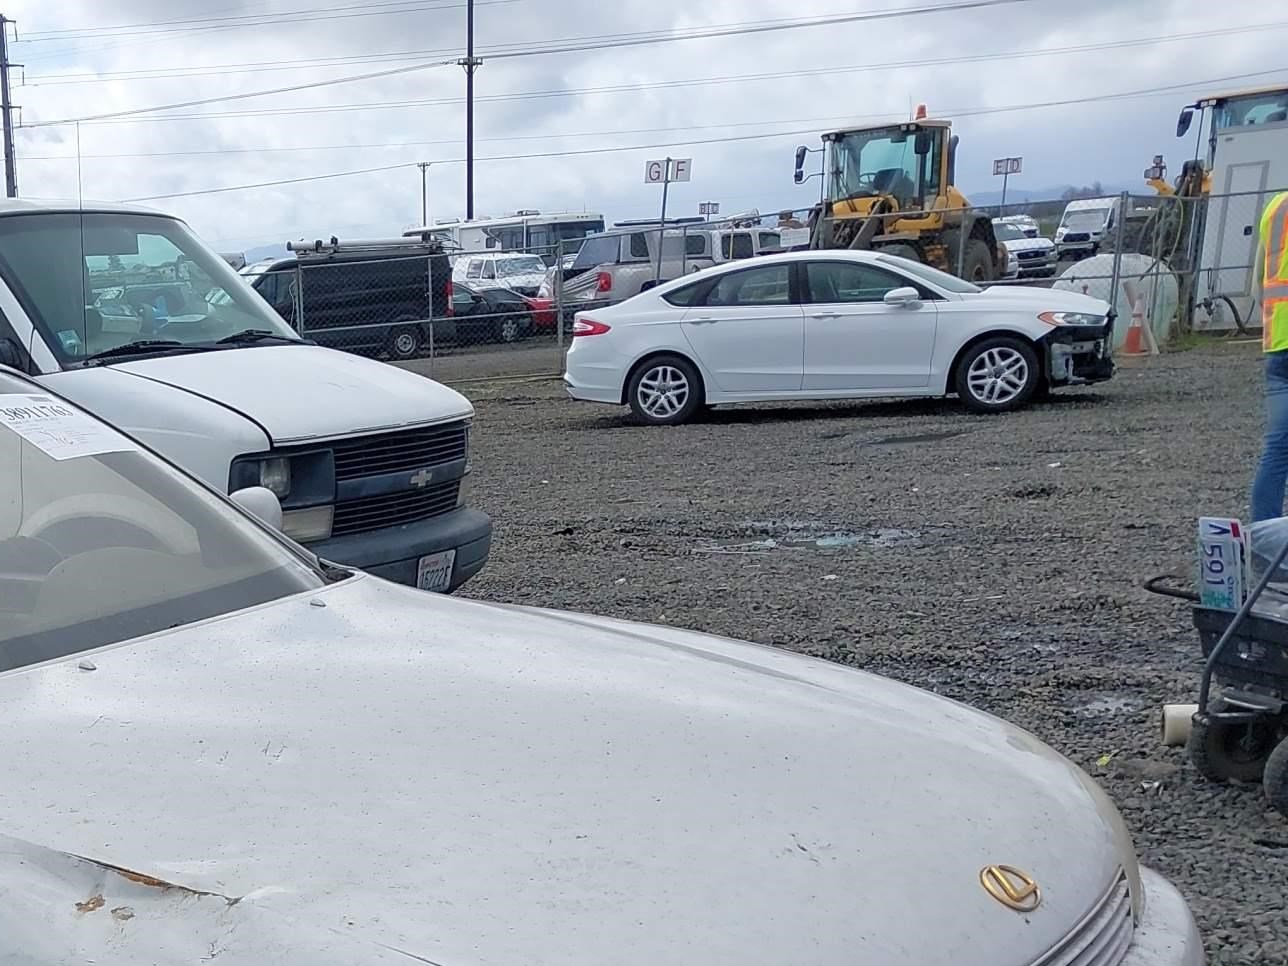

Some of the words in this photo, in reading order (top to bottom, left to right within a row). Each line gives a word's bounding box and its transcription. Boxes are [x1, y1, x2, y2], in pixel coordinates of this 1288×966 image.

[648, 162, 661, 181] G
[675, 160, 687, 180] F
[1203, 544, 1225, 585] 591
